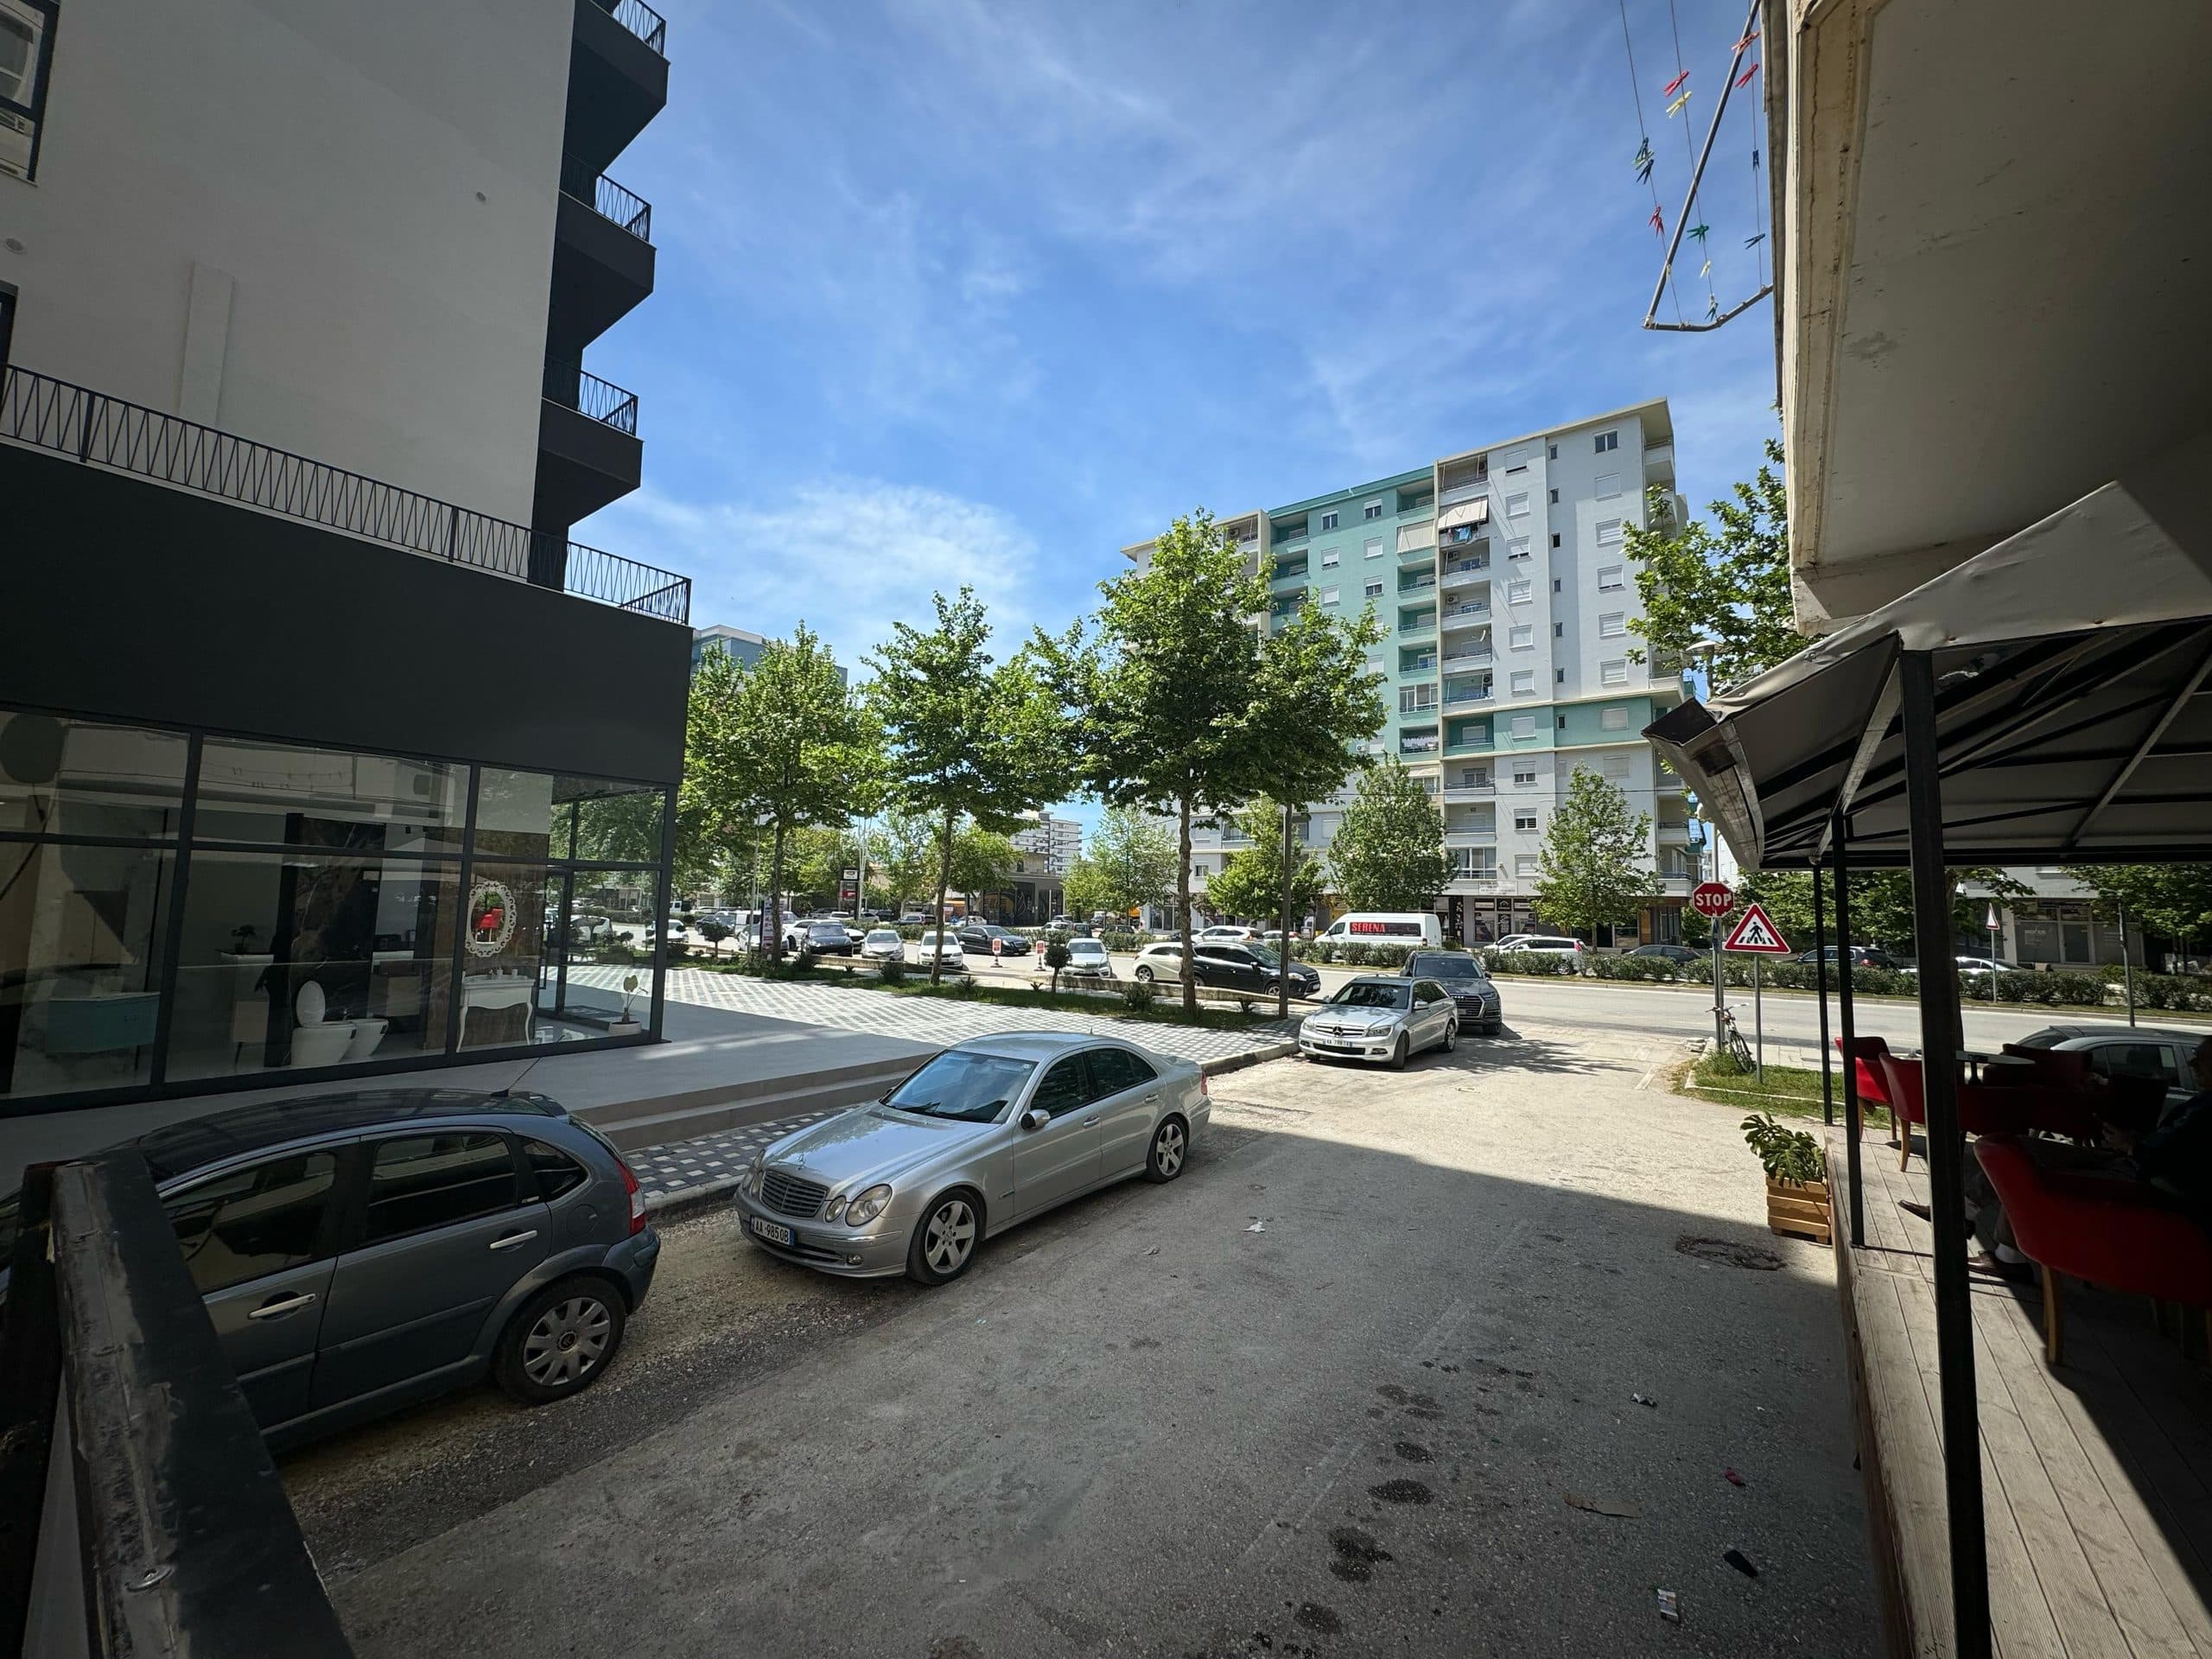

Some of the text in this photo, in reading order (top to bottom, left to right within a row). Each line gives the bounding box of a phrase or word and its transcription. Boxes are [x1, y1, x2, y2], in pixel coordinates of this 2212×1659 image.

[1695, 893, 1732, 906] STOP
[1351, 923, 1386, 933] SERENA
[755, 1220, 764, 1234] AA
